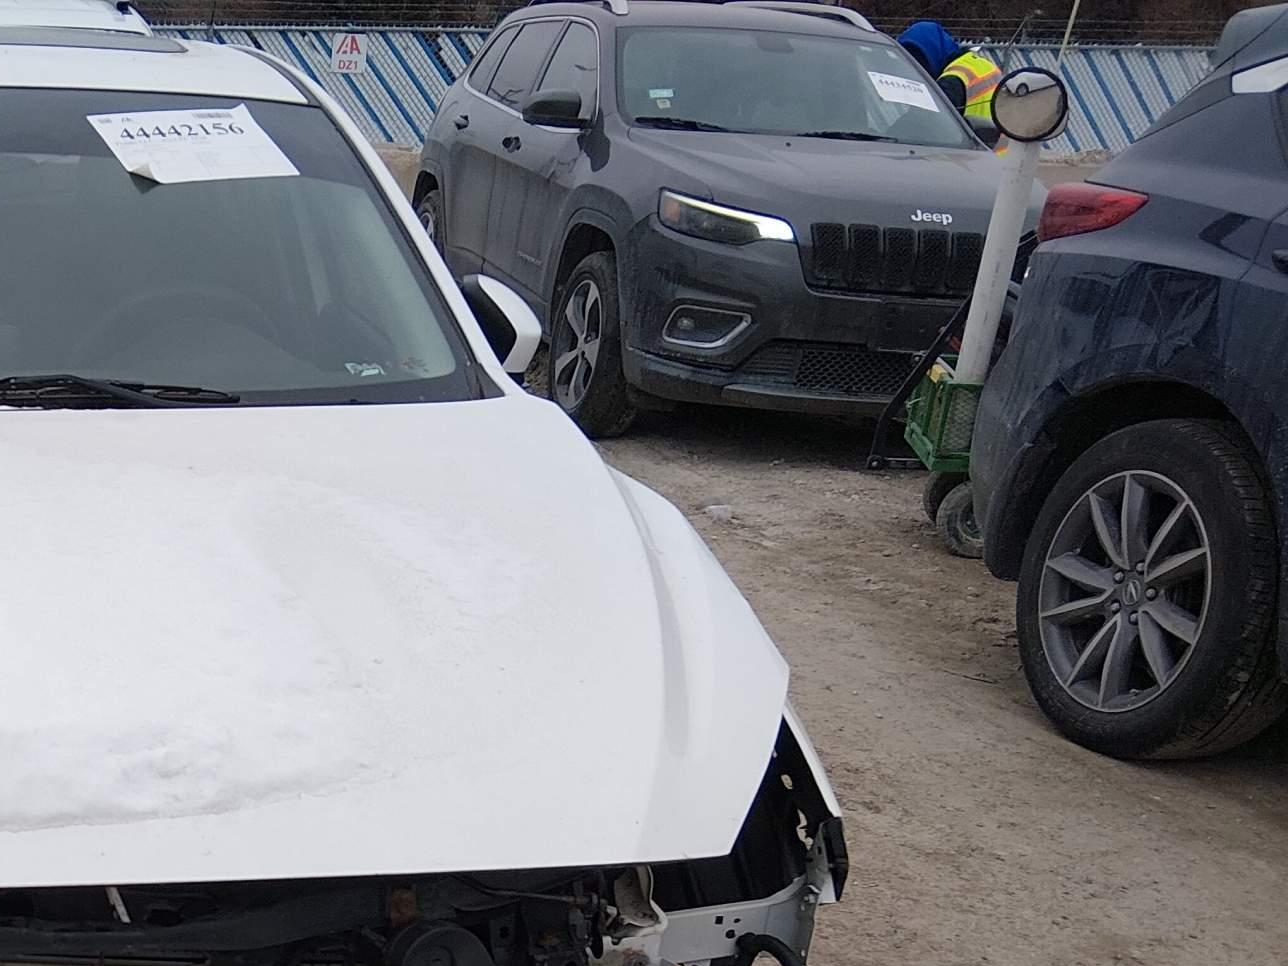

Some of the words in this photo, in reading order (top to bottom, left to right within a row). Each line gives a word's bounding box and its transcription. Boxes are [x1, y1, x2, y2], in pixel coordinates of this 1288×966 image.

[338, 59, 358, 71] DZ1
[120, 122, 245, 140] 44442156
[911, 209, 953, 225] Jeep
